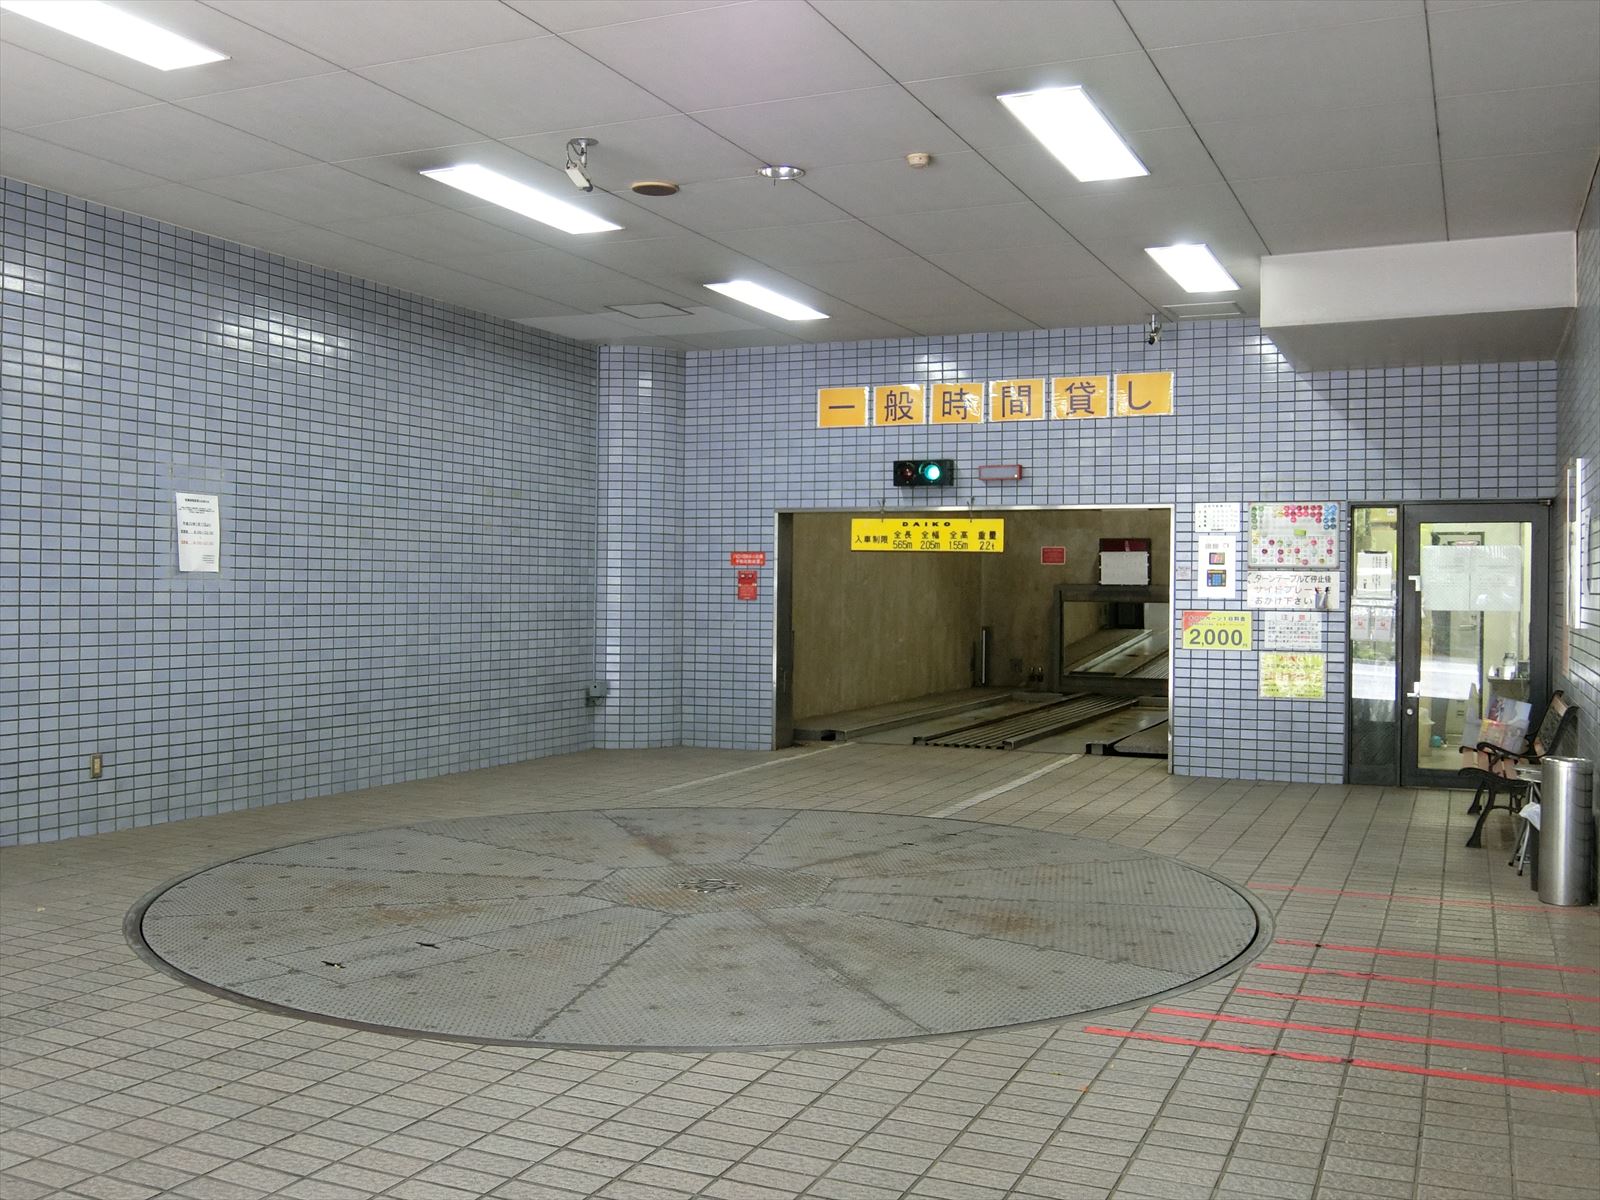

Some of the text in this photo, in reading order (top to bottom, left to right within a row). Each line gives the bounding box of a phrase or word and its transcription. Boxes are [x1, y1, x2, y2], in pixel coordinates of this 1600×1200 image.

[828, 380, 1153, 422] 一般時間貸し
[855, 535, 888, 544] 入車制限
[894, 530, 997, 540] 全長 全幅 全高 重量
